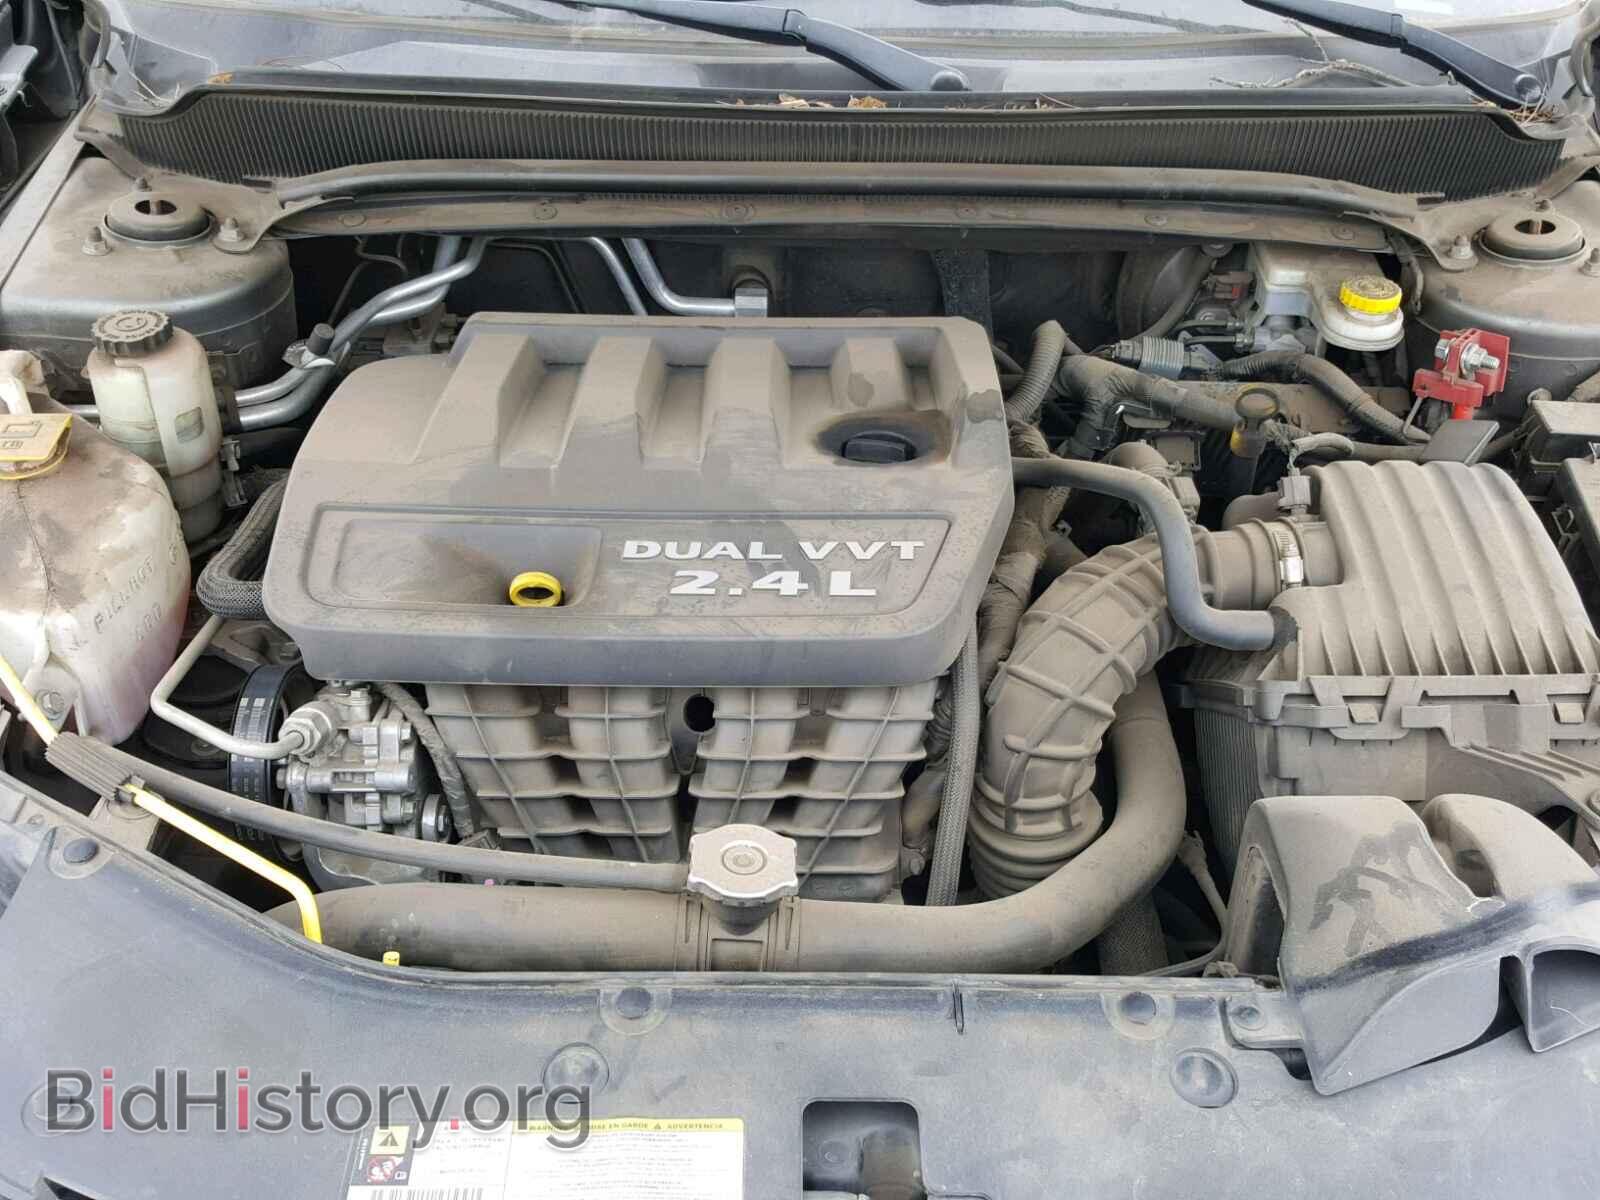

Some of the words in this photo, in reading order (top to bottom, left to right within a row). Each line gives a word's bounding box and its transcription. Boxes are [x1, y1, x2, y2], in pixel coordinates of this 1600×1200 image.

[622, 540, 783, 560] DUAL
[799, 540, 925, 561] VVT
[669, 570, 809, 597] 2.4
[829, 570, 877, 597] L
